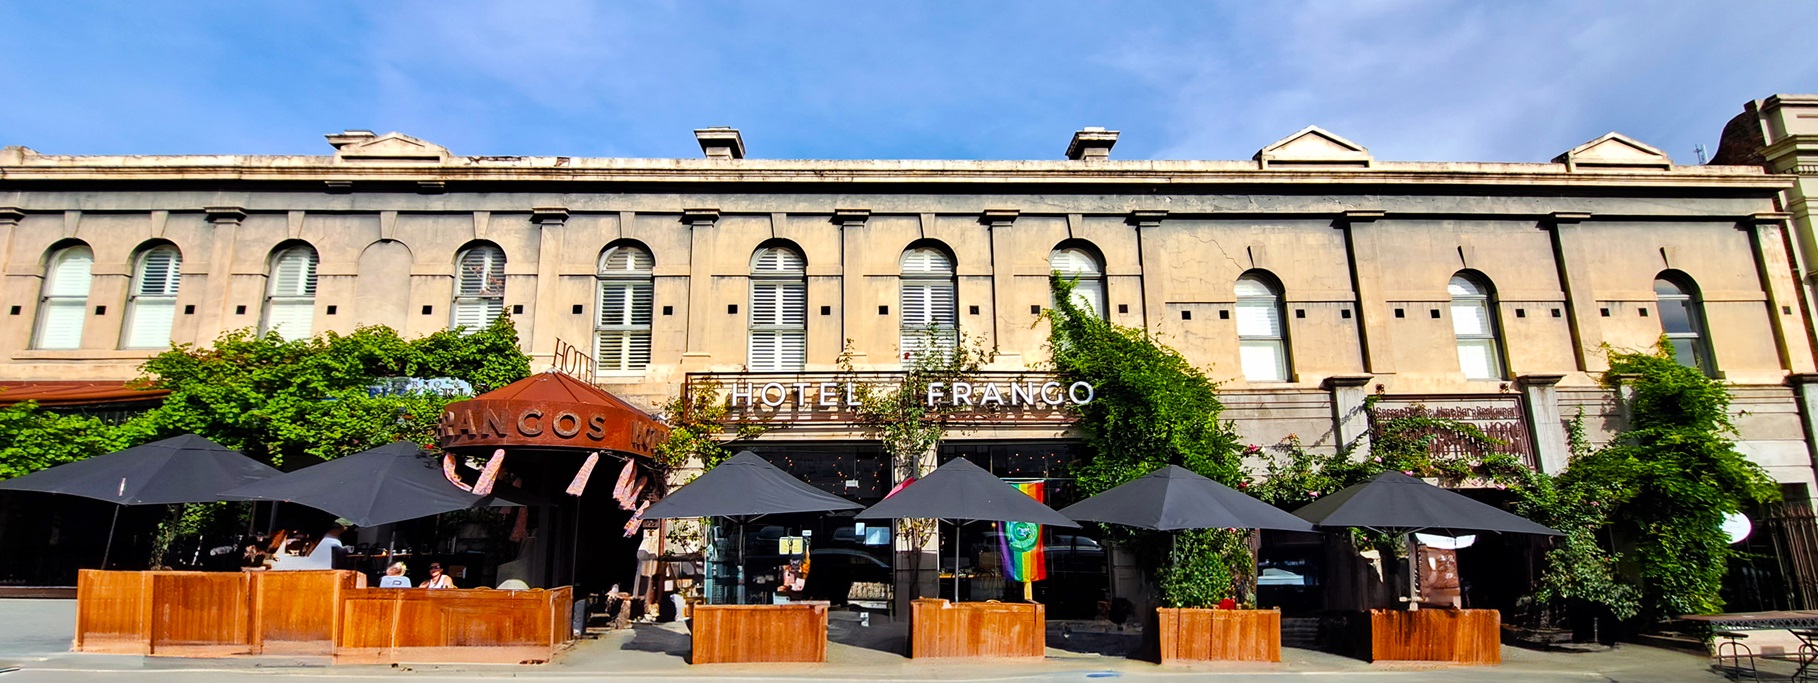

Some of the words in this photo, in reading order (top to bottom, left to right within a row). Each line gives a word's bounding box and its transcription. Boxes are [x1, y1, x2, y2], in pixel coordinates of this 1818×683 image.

[552, 337, 600, 388] HOTEL
[731, 382, 862, 407] HOTEL
[927, 381, 1094, 406] FRANGO
